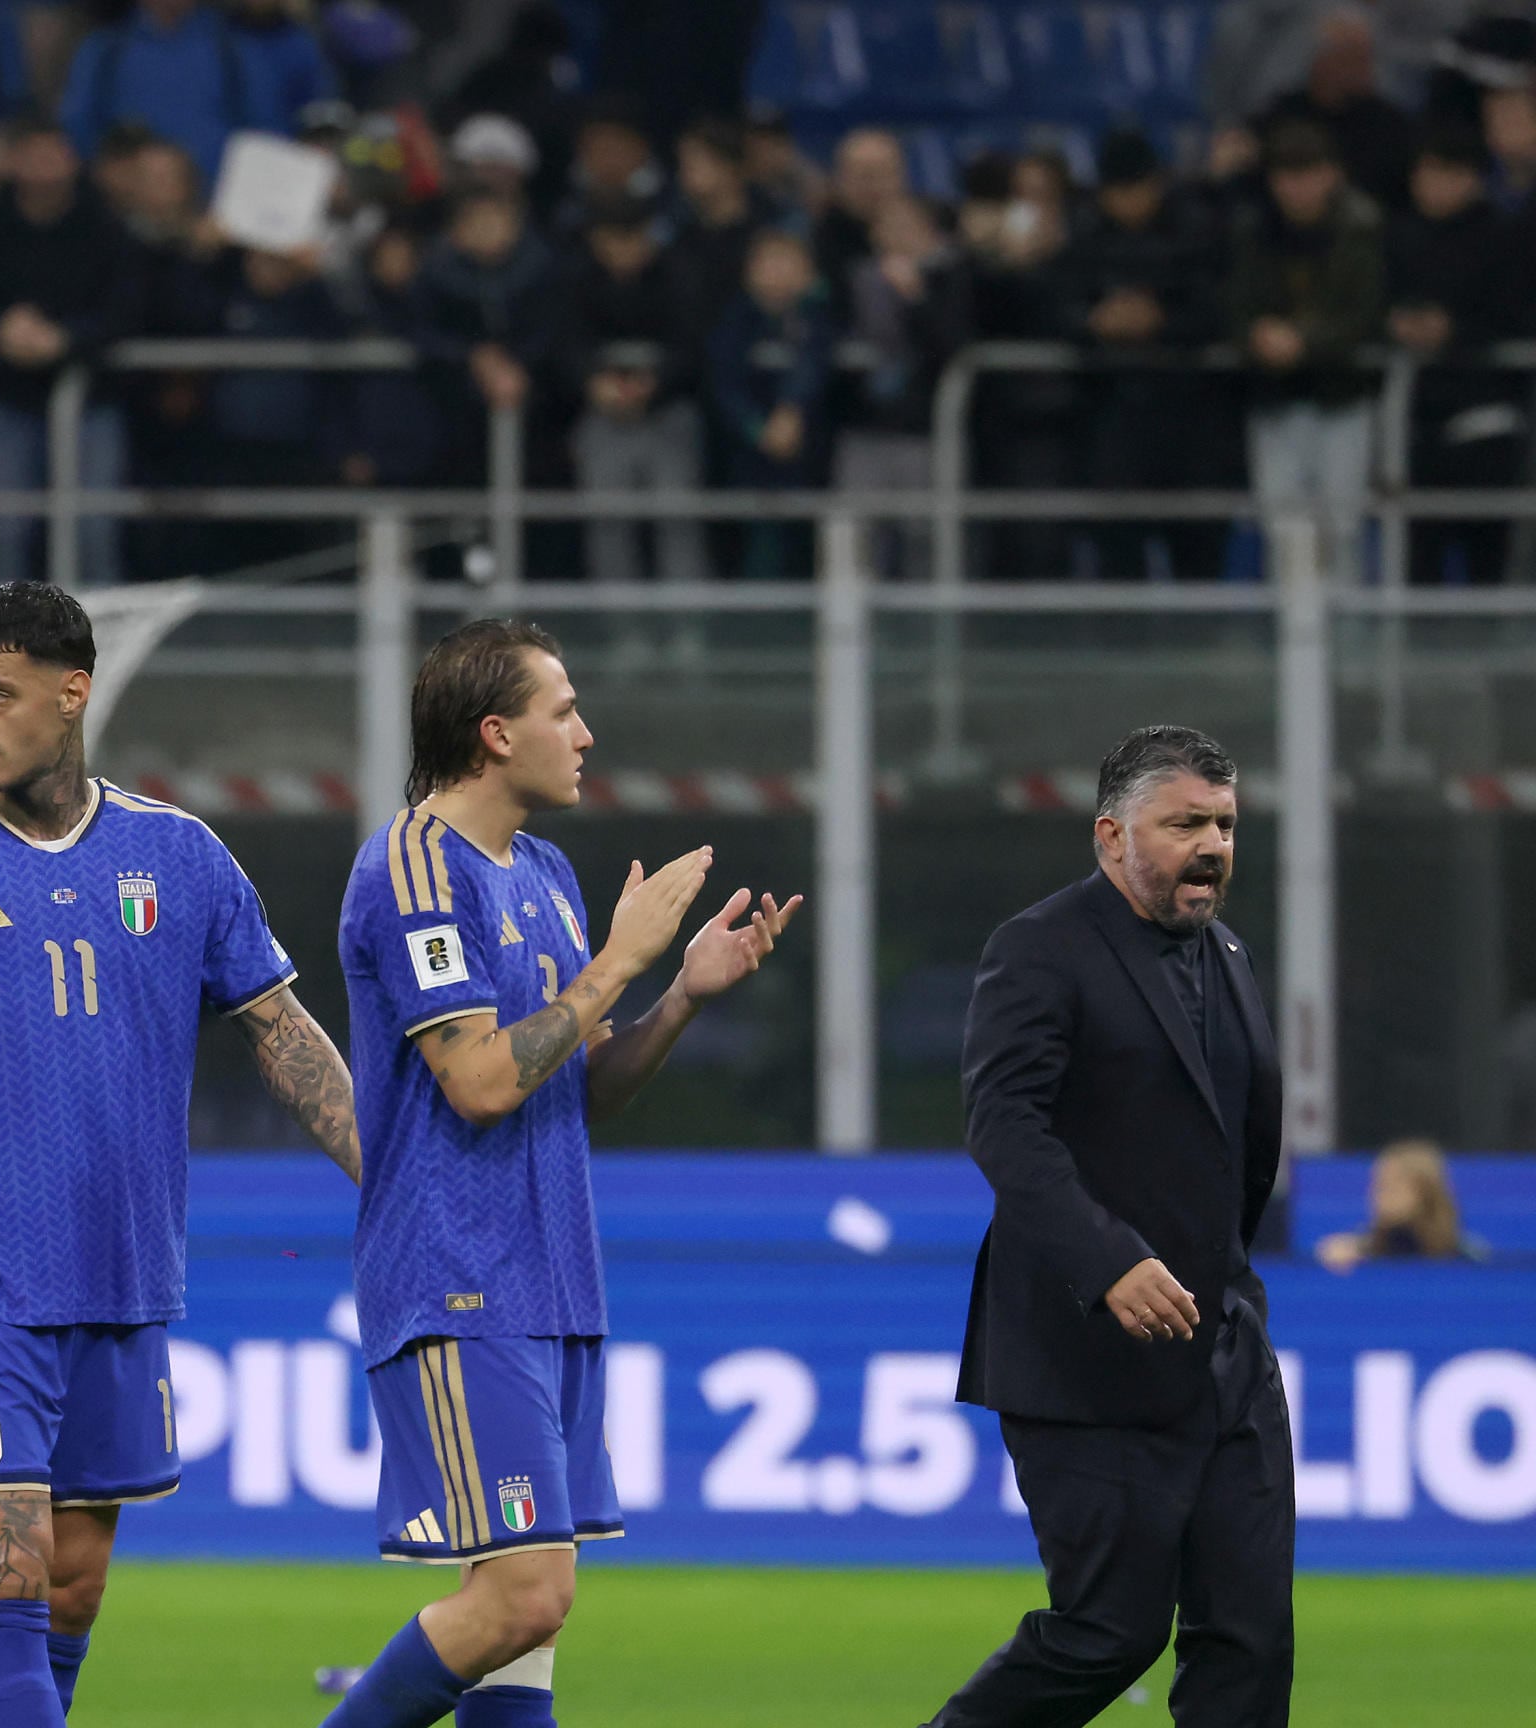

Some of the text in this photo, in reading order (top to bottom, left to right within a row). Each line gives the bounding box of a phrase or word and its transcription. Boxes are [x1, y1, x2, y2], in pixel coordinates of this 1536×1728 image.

[121, 884, 153, 895] ITALIA
[44, 939, 98, 1017] 11
[157, 1378, 173, 1454] 1
[698, 1347, 977, 1516] 2.5
[501, 1486, 529, 1500] ITALIA
